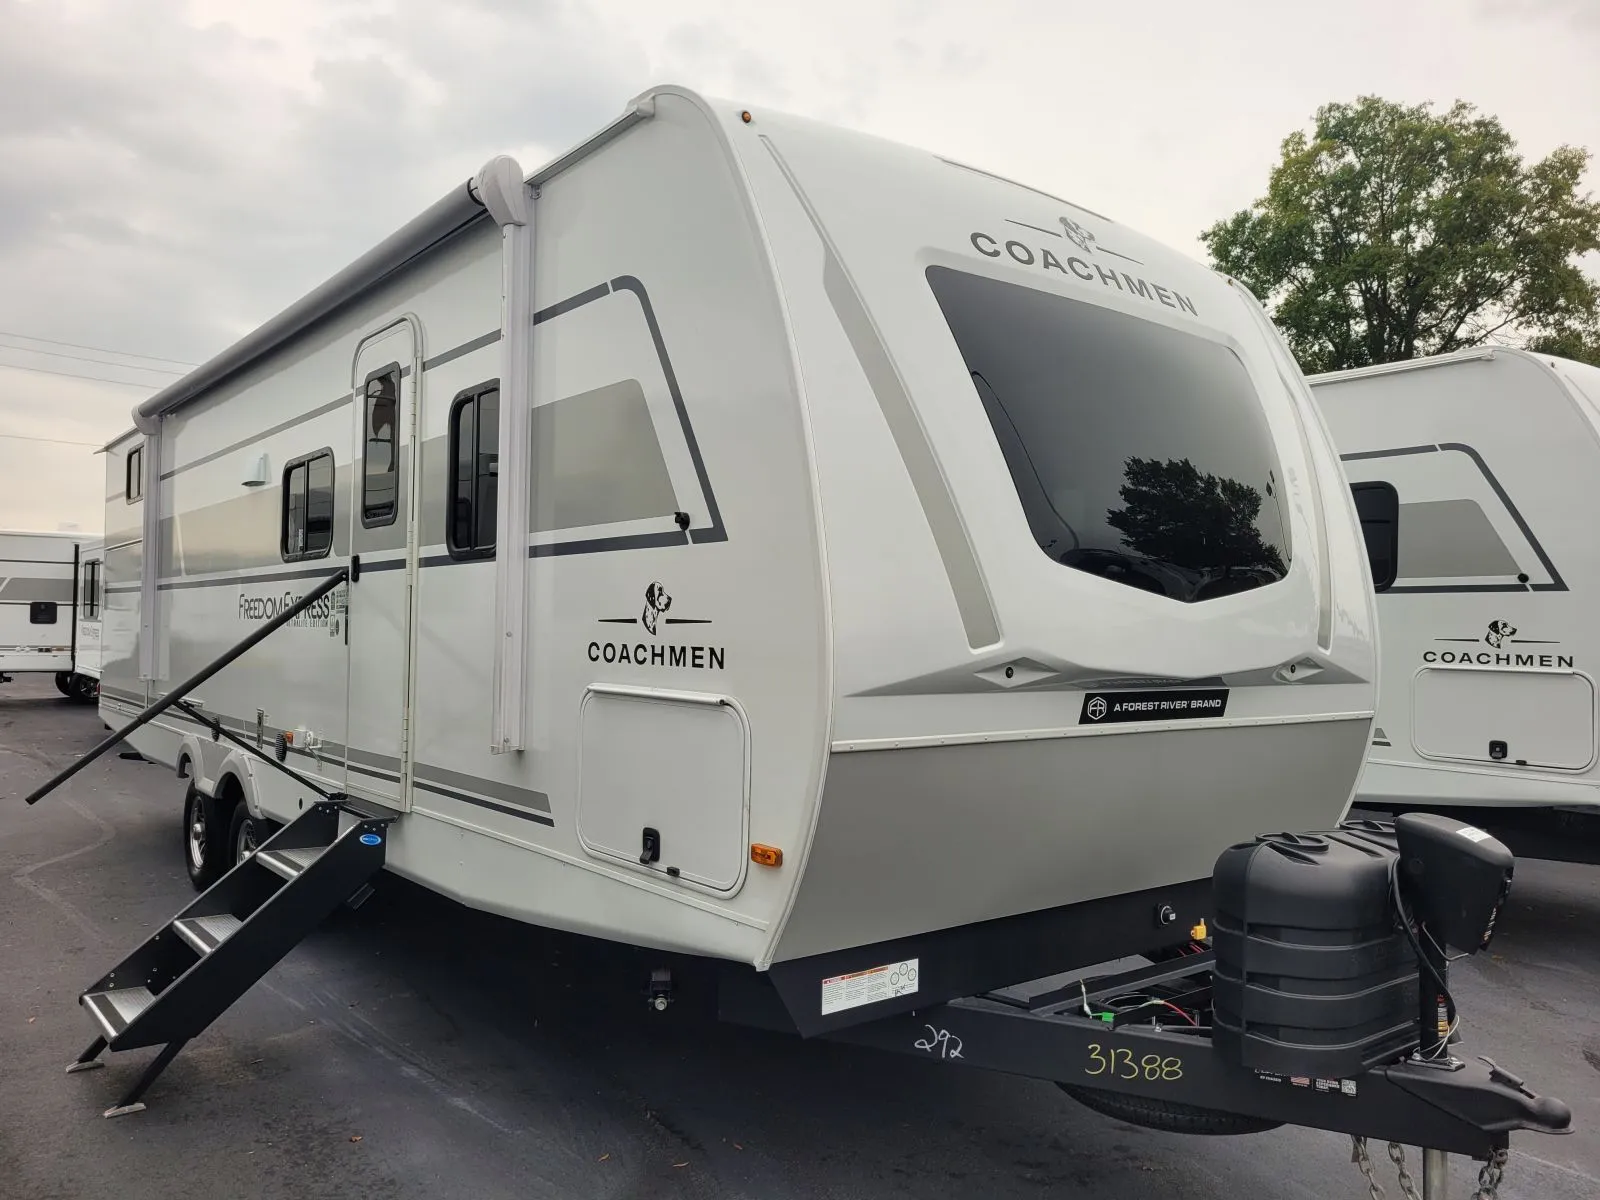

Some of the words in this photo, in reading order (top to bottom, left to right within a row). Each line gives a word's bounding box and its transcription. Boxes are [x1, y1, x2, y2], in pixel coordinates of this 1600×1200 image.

[970, 231, 1198, 317] COACHMEN
[588, 641, 725, 669] COACHMEN
[1423, 651, 1574, 668] COACHMEN
[1113, 704, 1122, 712] A
[1123, 702, 1159, 711] FOREST
[1191, 699, 1221, 709] BRAND
[914, 1024, 964, 1059] 292
[1084, 1044, 1183, 1081] 31388
